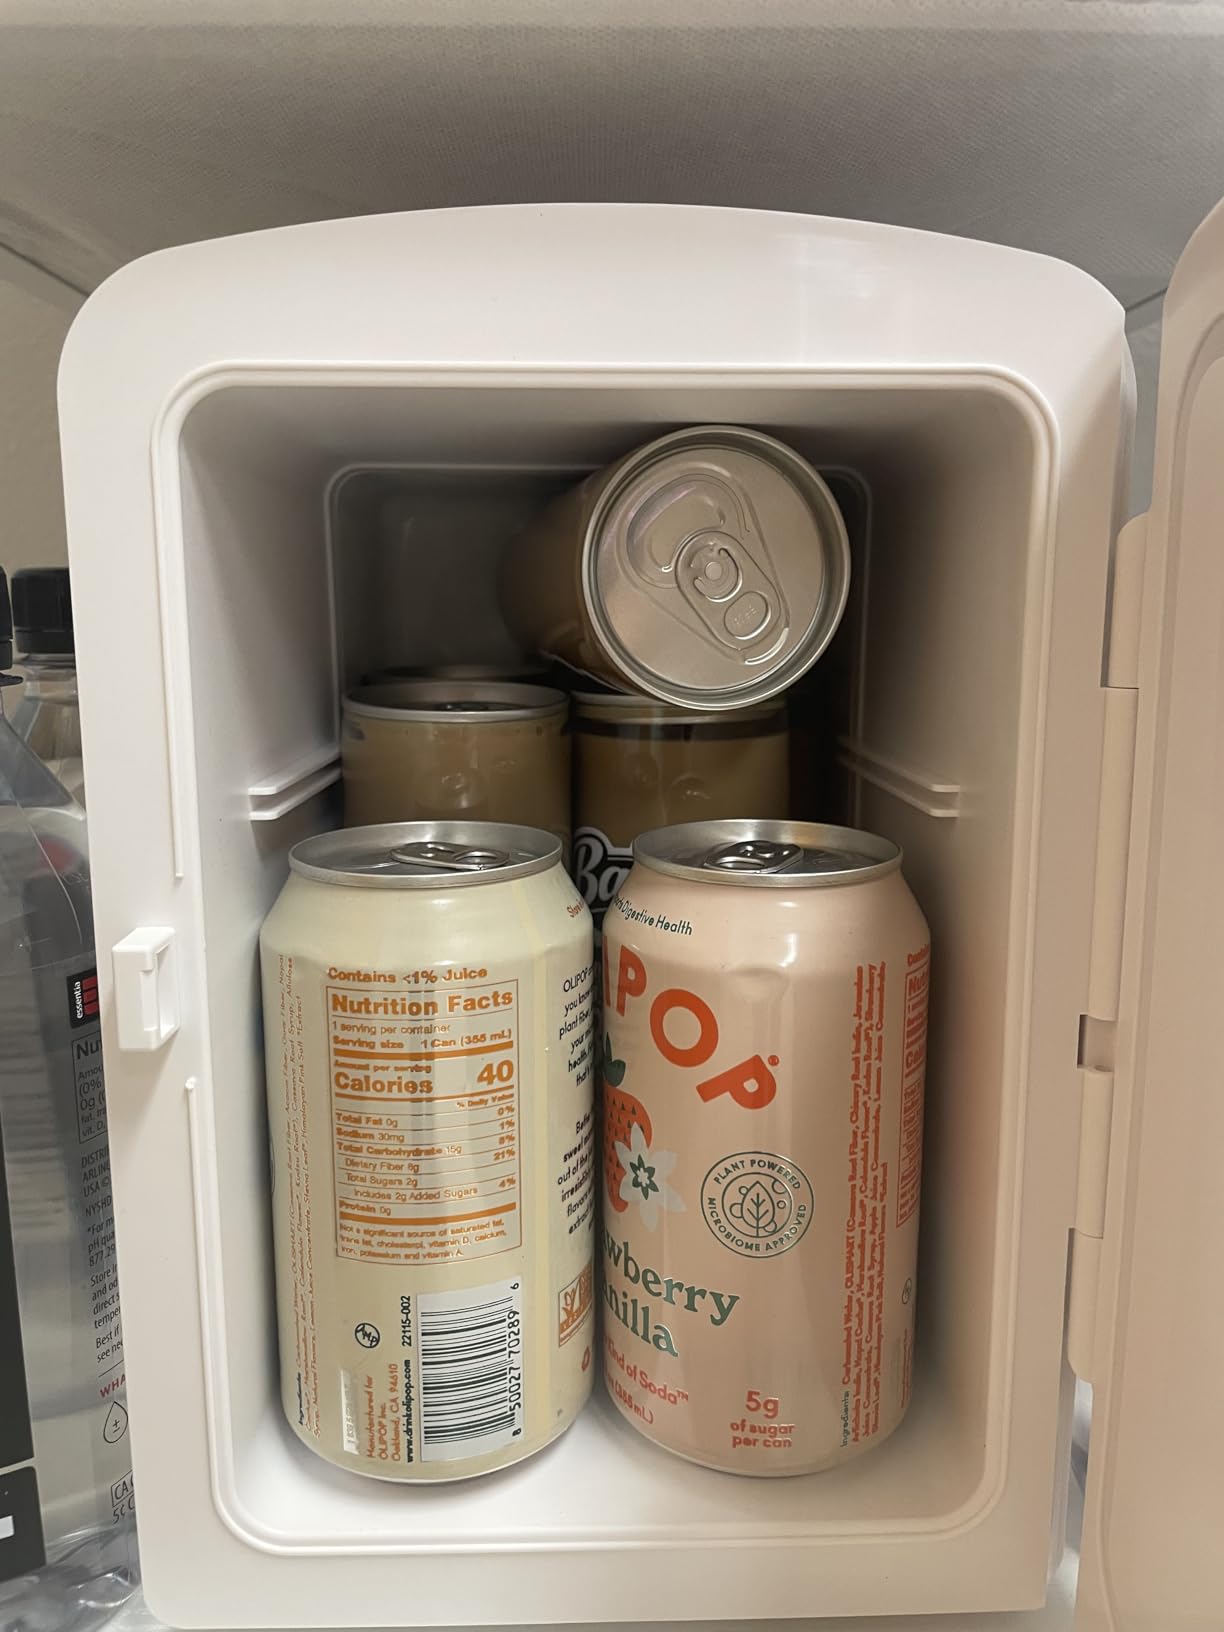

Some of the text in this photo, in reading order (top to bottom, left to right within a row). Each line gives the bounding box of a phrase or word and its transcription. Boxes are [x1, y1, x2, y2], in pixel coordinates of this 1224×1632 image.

[621, 900, 655, 928] Digestive
[655, 914, 693, 936] Health
[327, 967, 488, 985] Contains <1% Juice
[73, 981, 84, 1019] essentia
[331, 990, 513, 1017] Nutrition Facts
[564, 999, 578, 1018] you
[340, 1022, 377, 1035] serving
[380, 1025, 397, 1036] per
[559, 1014, 578, 1040] plant
[334, 1059, 514, 1095] Calories 40
[335, 1111, 362, 1125] Total
[365, 1115, 384, 1126] Fat
[386, 1117, 398, 1129] 0g
[377, 1132, 405, 1144] 30mg
[345, 1157, 378, 1172] Dietary
[380, 1161, 404, 1172] Fiber
[713, 1158, 802, 1190] PLANT POWERED
[346, 1172, 418, 1189] Total Sugars 2g
[557, 1166, 571, 1186] out
[83, 1181, 100, 1198] USA
[408, 1190, 441, 1201] Added
[443, 1186, 478, 1199] Sugars
[707, 1196, 807, 1252] MICROBIOME APPROVED
[88, 1239, 100, 1256] pH
[90, 1268, 111, 1288] Store
[510, 1281, 520, 1290] 6
[91, 1285, 107, 1302] and
[93, 1295, 116, 1316] direct
[400, 1295, 412, 1347] 22115-002
[95, 1331, 113, 1350] Best
[507, 1309, 520, 1359] 70289
[97, 1346, 111, 1364] see
[625, 1364, 638, 1382] of
[508, 1366, 522, 1413] 50027
[389, 1397, 400, 1414] CA
[401, 1359, 415, 1464] www.drinkolipop.com
[745, 1390, 780, 1420] 5g
[377, 1416, 389, 1460] OLIPOP
[730, 1418, 796, 1439] of sugar
[731, 1435, 793, 1449] per can
[114, 1479, 129, 1501] CA
